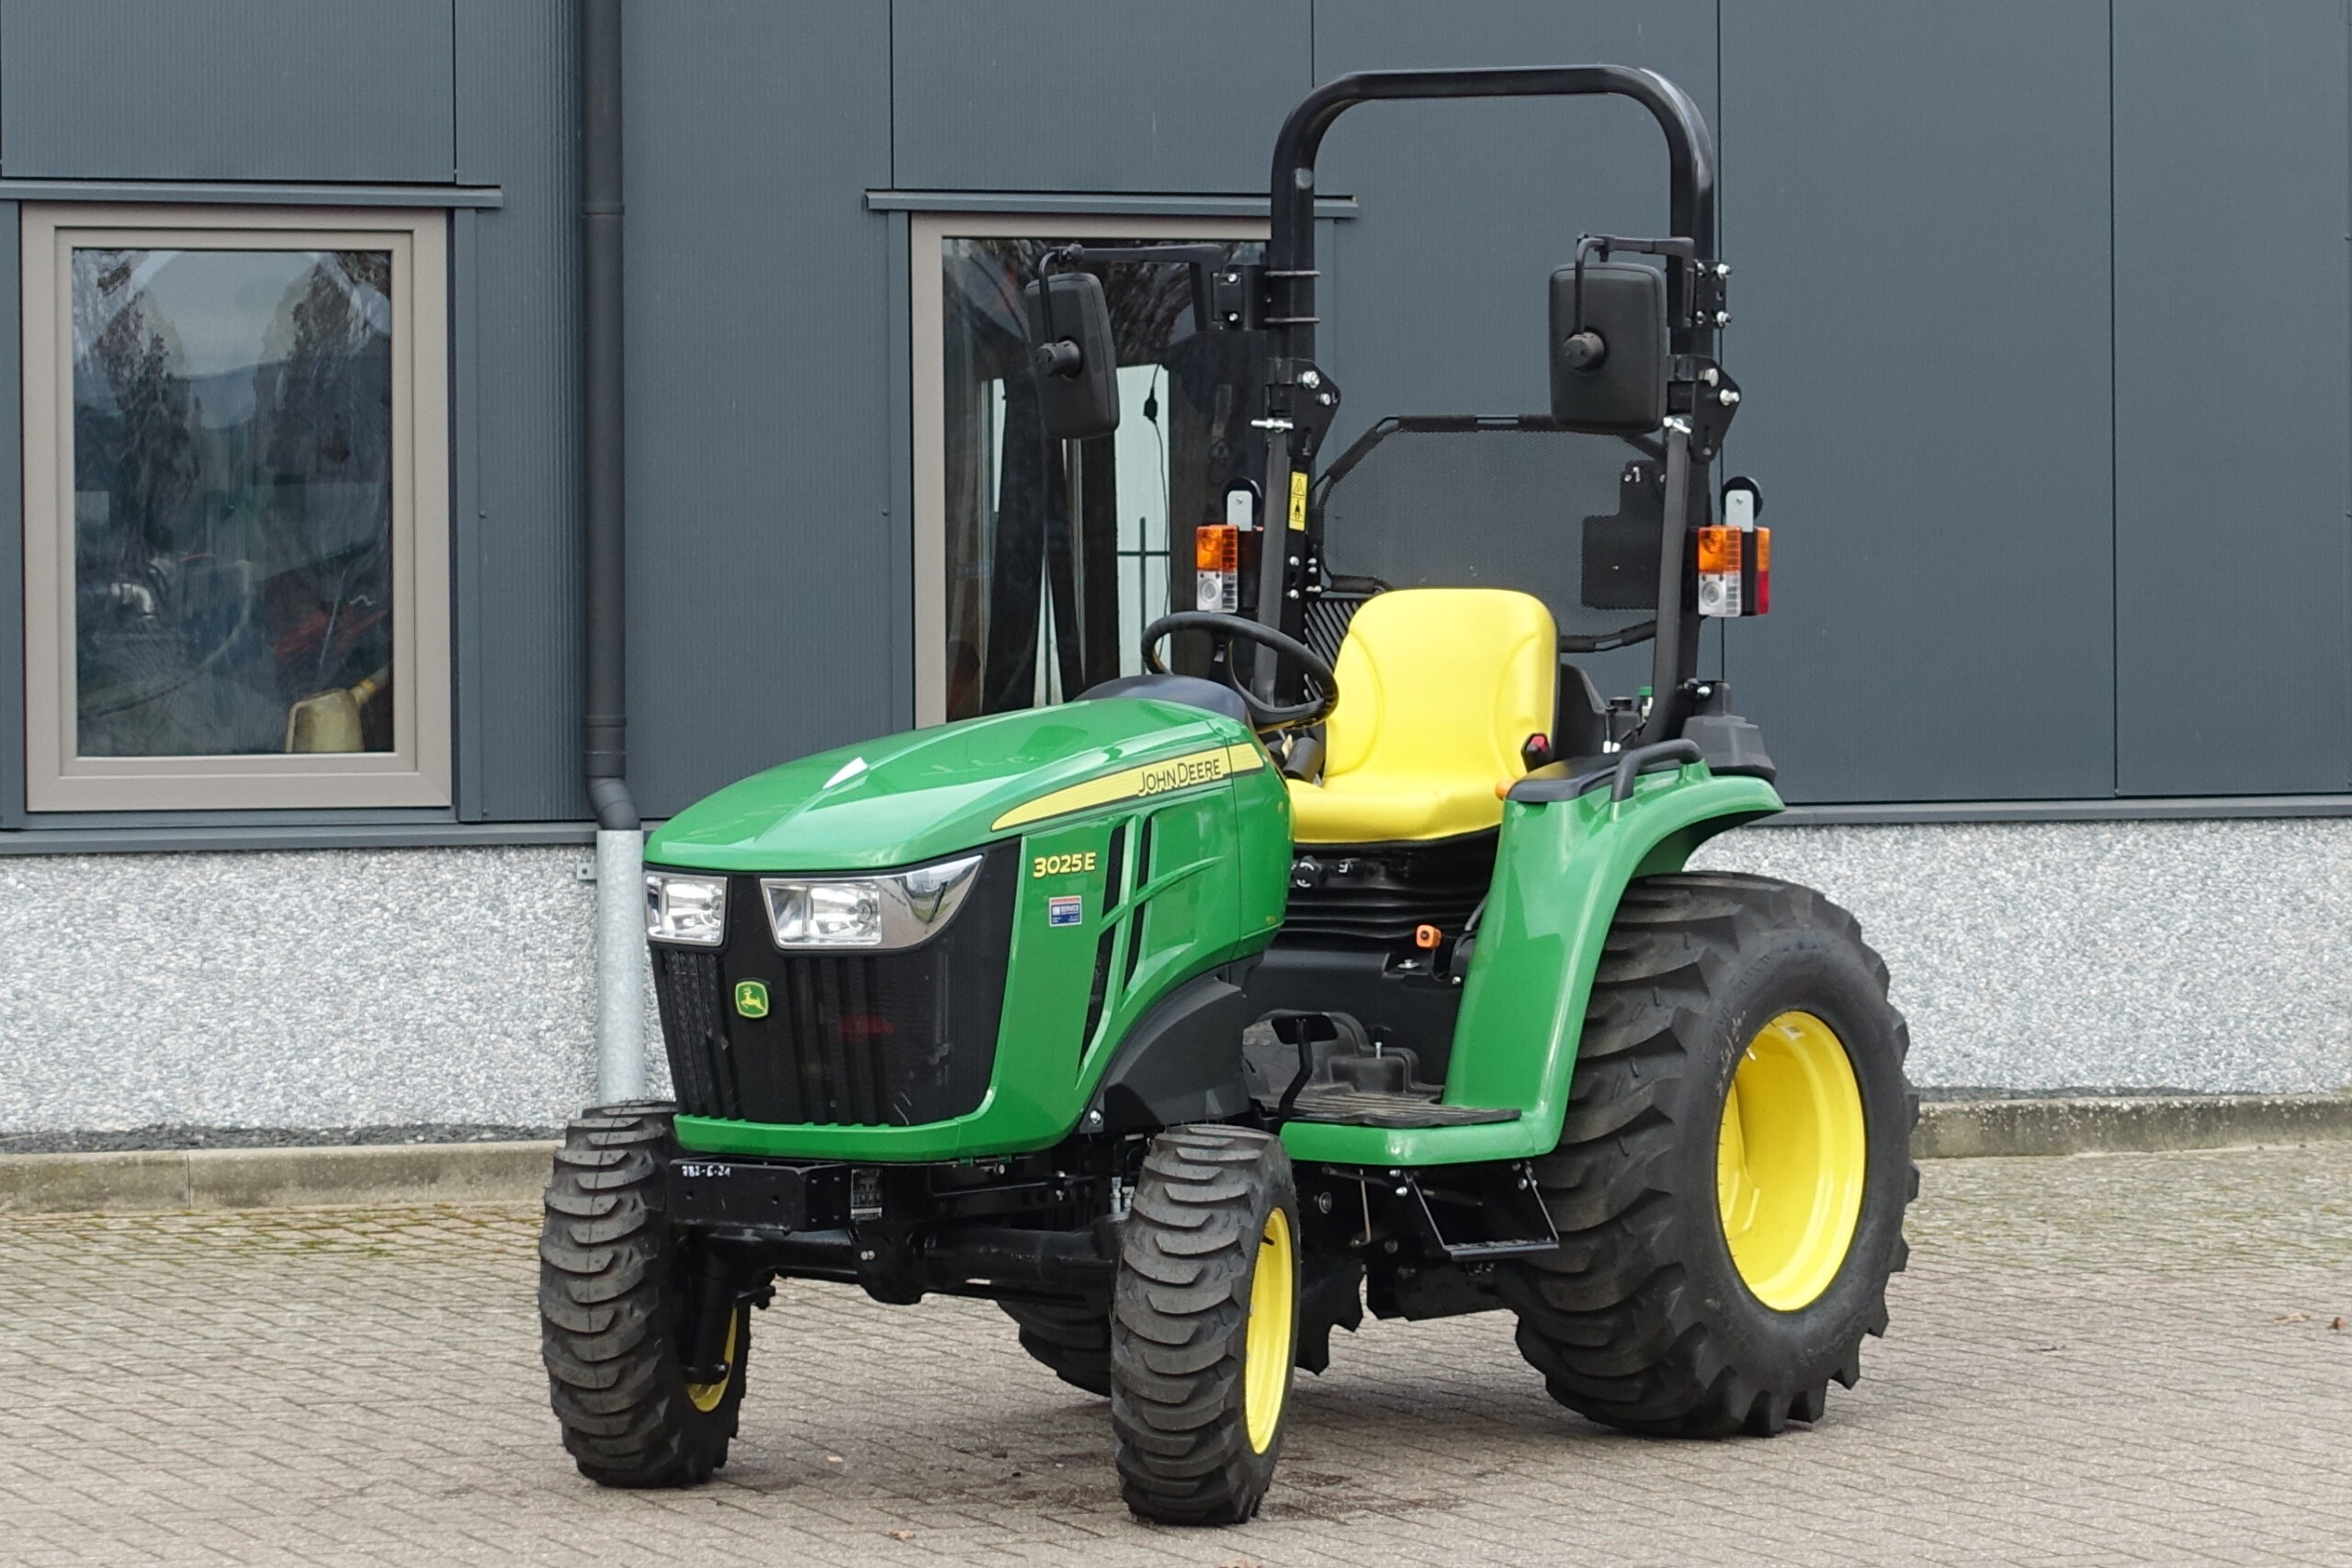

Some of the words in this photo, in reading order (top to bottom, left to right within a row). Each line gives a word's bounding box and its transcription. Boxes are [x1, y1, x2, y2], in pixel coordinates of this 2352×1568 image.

[1138, 768, 1177, 793] JOHN
[1177, 759, 1221, 784] DEERE
[1033, 852, 1096, 878] 3025E
